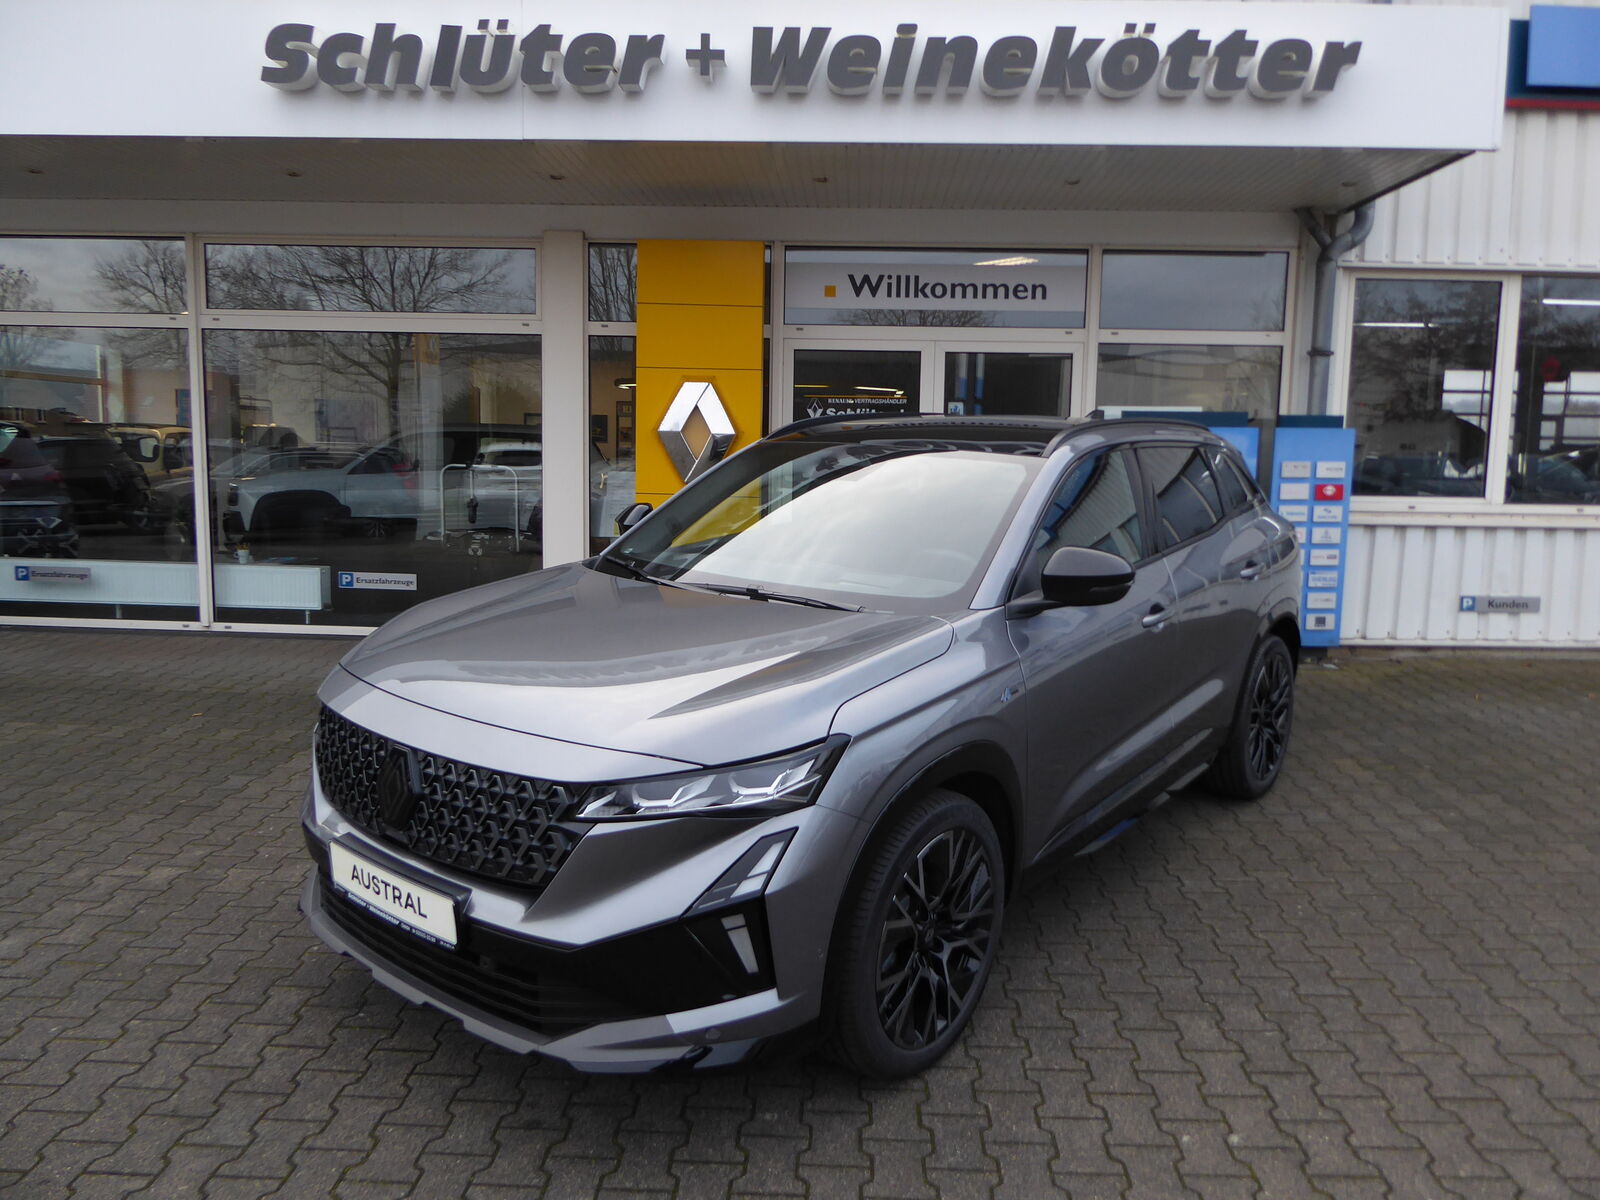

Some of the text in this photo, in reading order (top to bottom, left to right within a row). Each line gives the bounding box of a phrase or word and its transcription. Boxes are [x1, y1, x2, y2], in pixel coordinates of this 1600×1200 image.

[260, 19, 1362, 96] Schlüter + Weinekötter
[847, 273, 1047, 300] Willkommen
[18, 568, 28, 579] P
[342, 574, 414, 587] P Ersatzfahrzeuge
[1462, 597, 1529, 609] P Kunden
[351, 864, 428, 918] AUSTRAL
